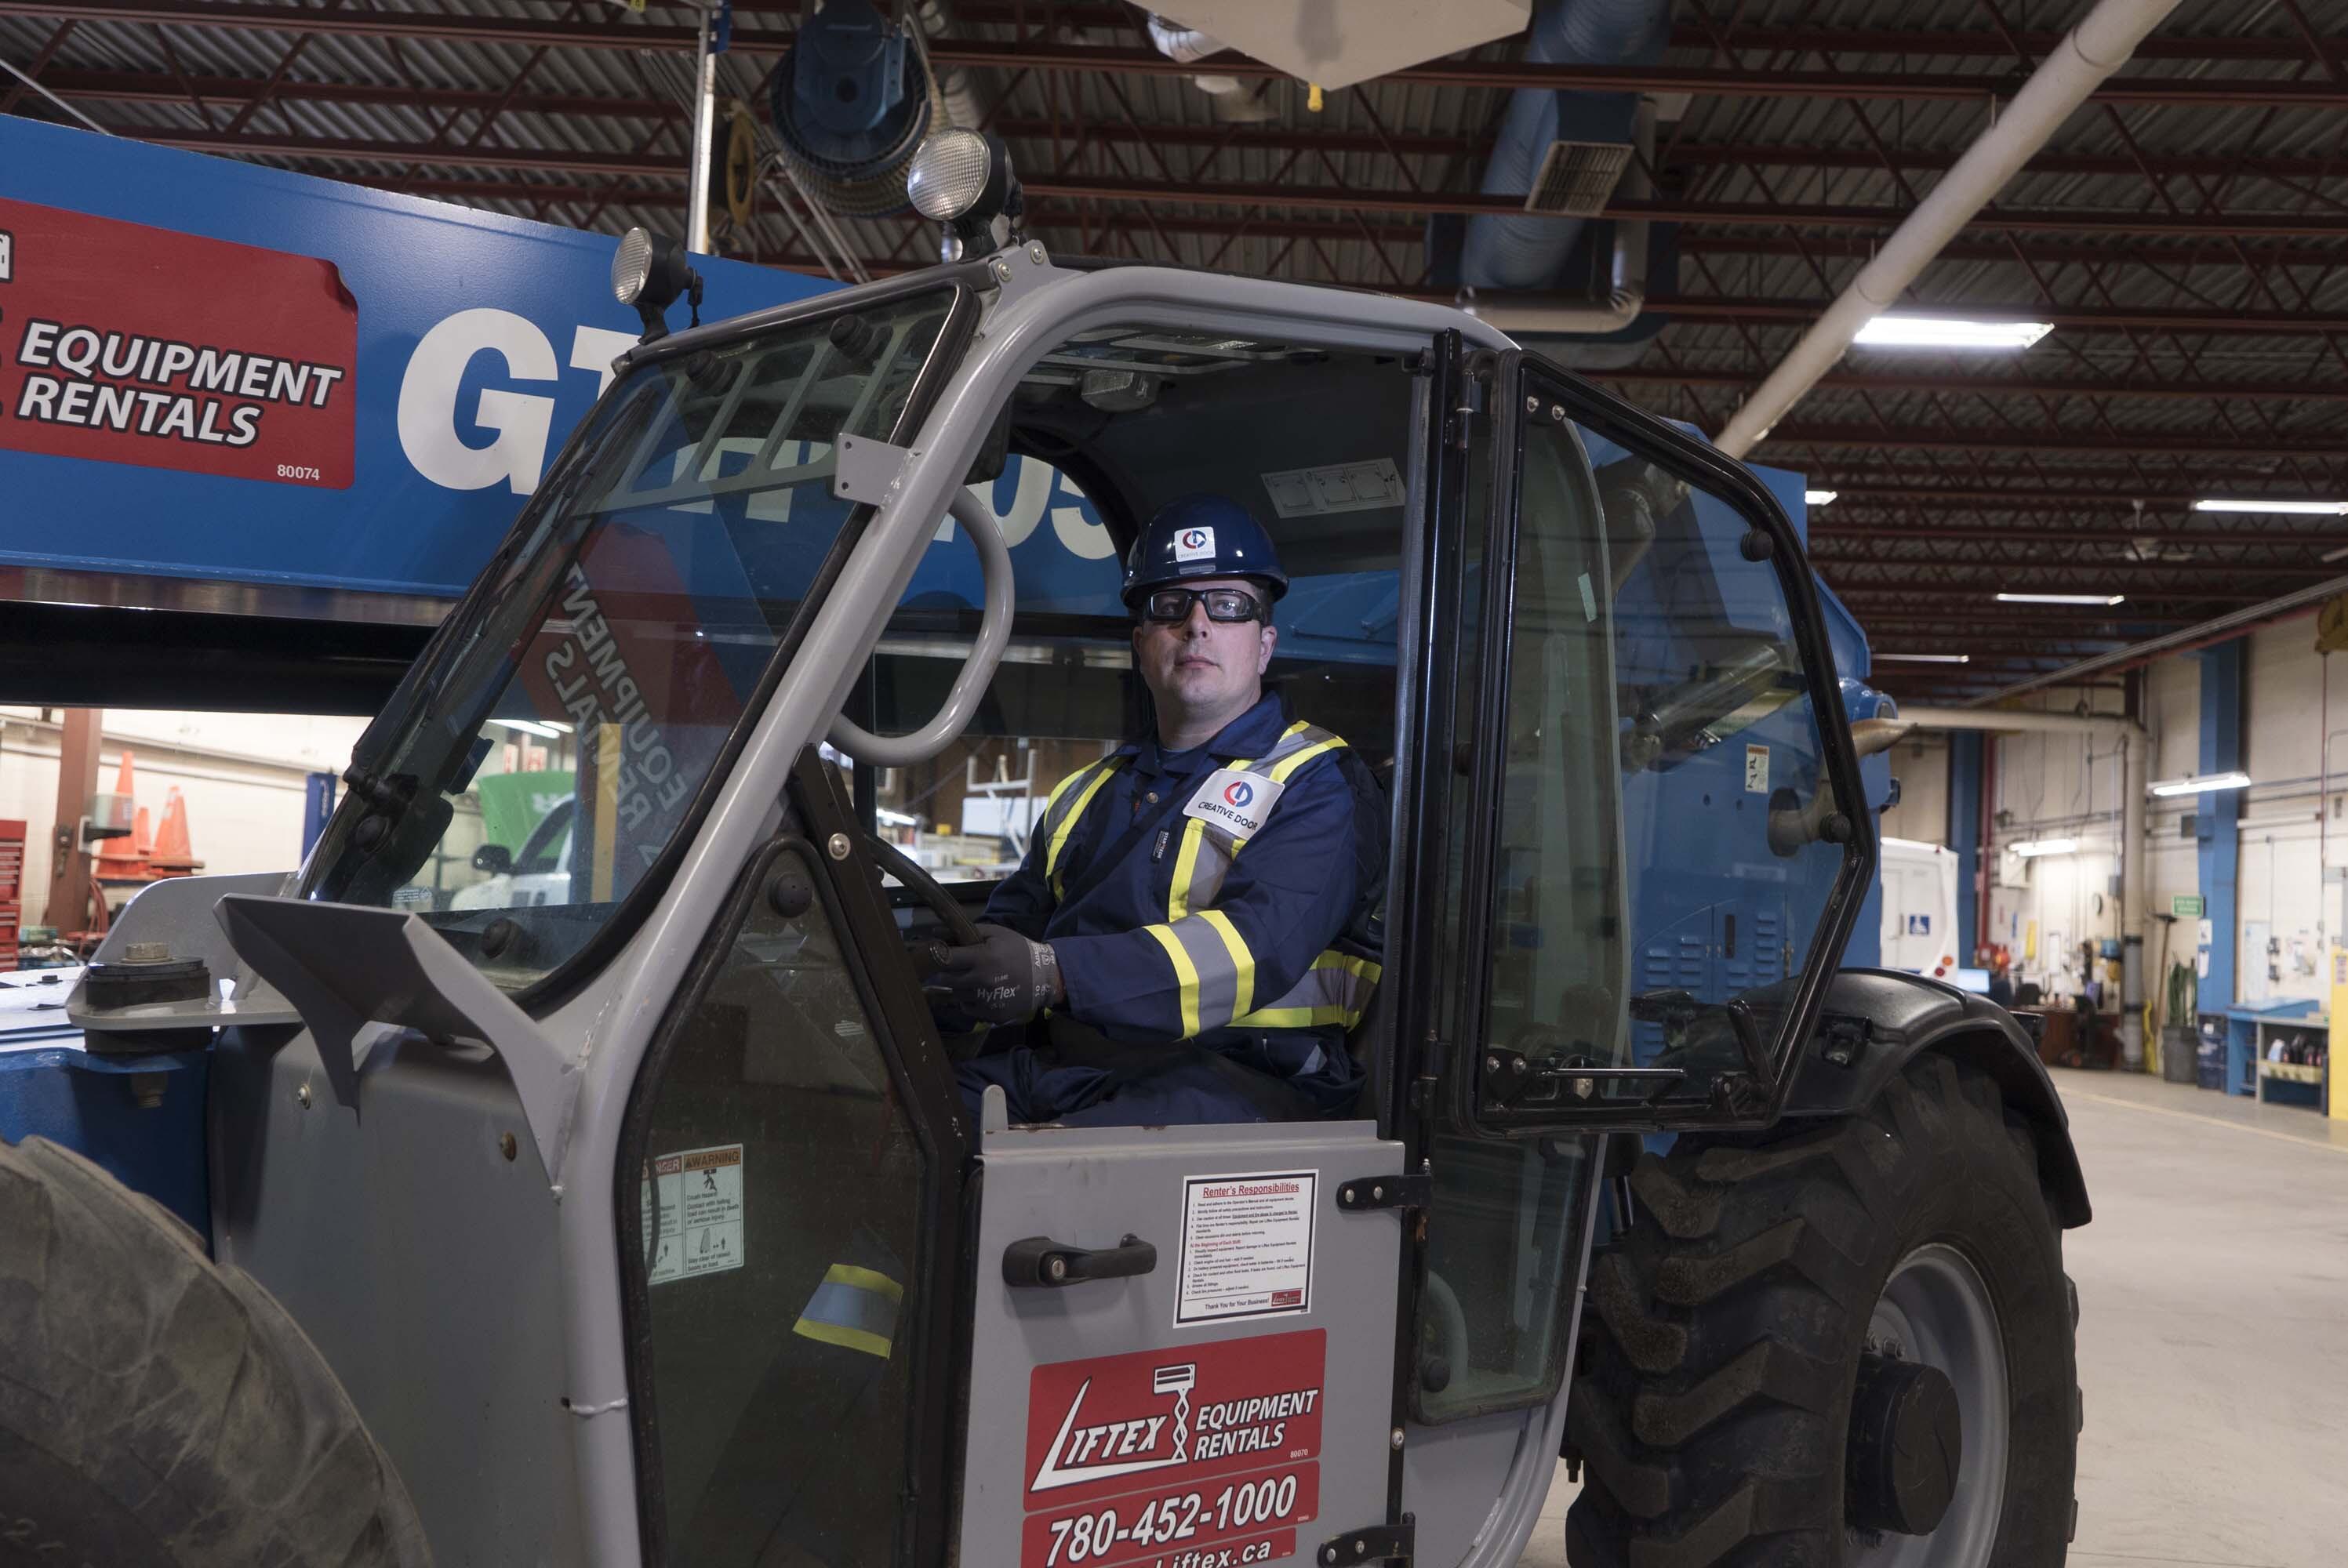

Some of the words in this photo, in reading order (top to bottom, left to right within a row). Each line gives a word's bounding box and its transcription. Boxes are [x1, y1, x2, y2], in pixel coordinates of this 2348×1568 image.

[20, 322, 342, 407] EQUIPMENT
[19, 377, 260, 445] RENTALS
[277, 464, 320, 481] 80074
[1198, 801, 1234, 819] CREATIVE
[1234, 815, 1258, 830] DOOR
[977, 985, 1016, 1003] HyFlex
[1203, 1185, 1236, 1197] Renter's
[1238, 1182, 1299, 1196] Responsibilities
[1195, 1389, 1318, 1431] EQUIPMENT
[1030, 1377, 1187, 1491] LIFTEX
[1194, 1423, 1285, 1461] RENTALS
[1290, 1448, 1308, 1459] 80070
[1047, 1475, 1297, 1567] 780-452-1000
